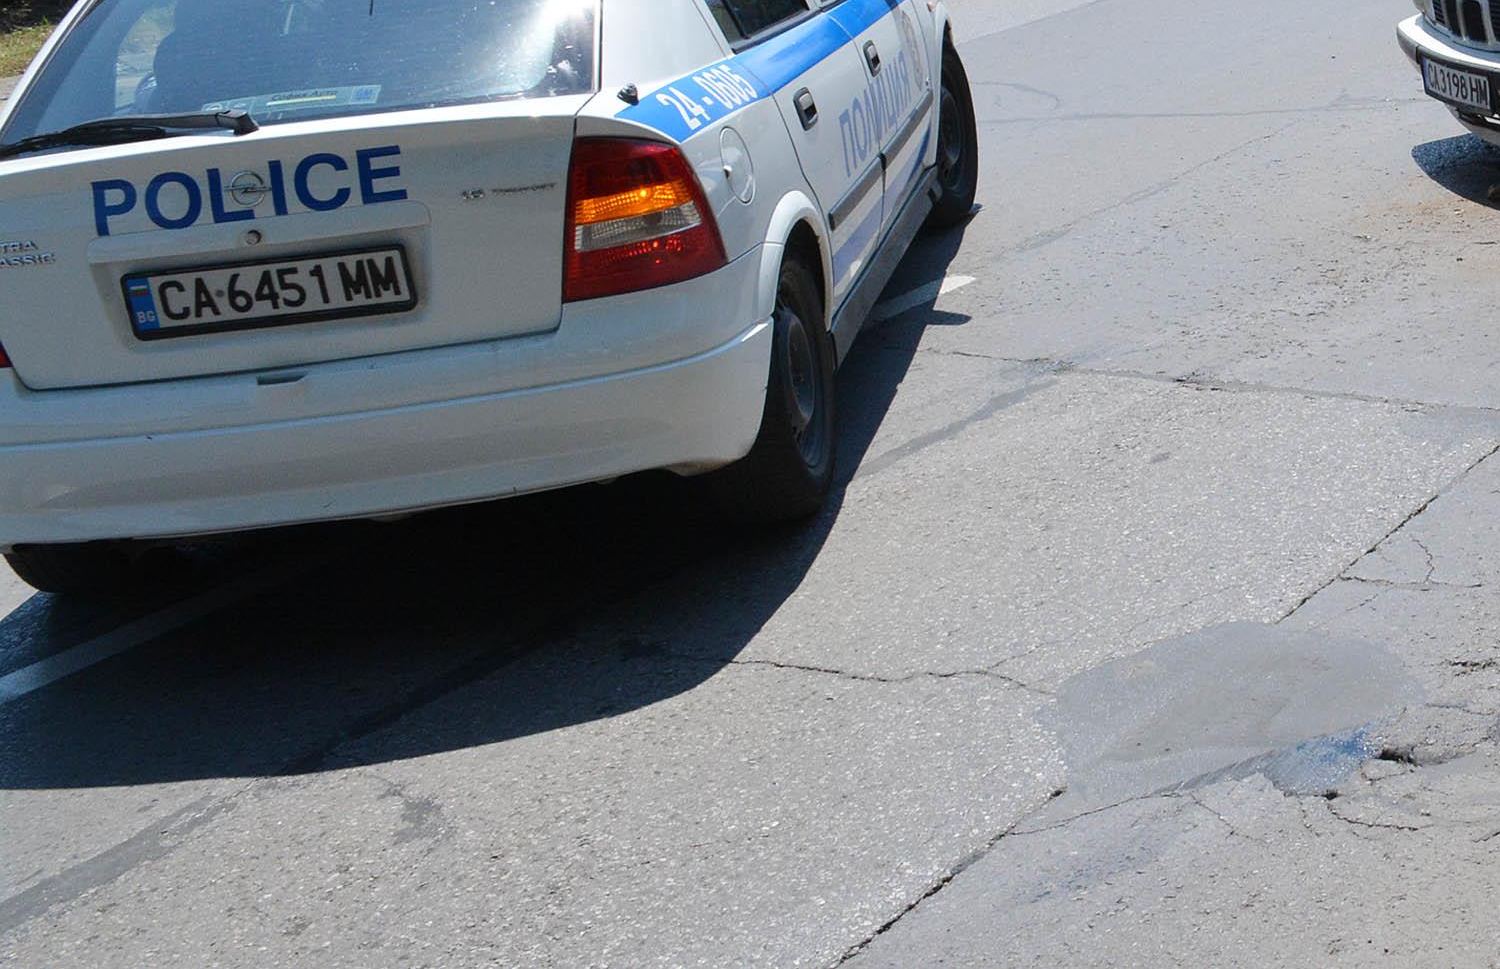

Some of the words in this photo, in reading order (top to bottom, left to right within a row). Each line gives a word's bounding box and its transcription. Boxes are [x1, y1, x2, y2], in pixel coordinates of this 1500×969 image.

[838, 49, 911, 178] ПОЛИЦИЯ
[90, 144, 408, 237] POLICE
[136, 310, 155, 323] BG
